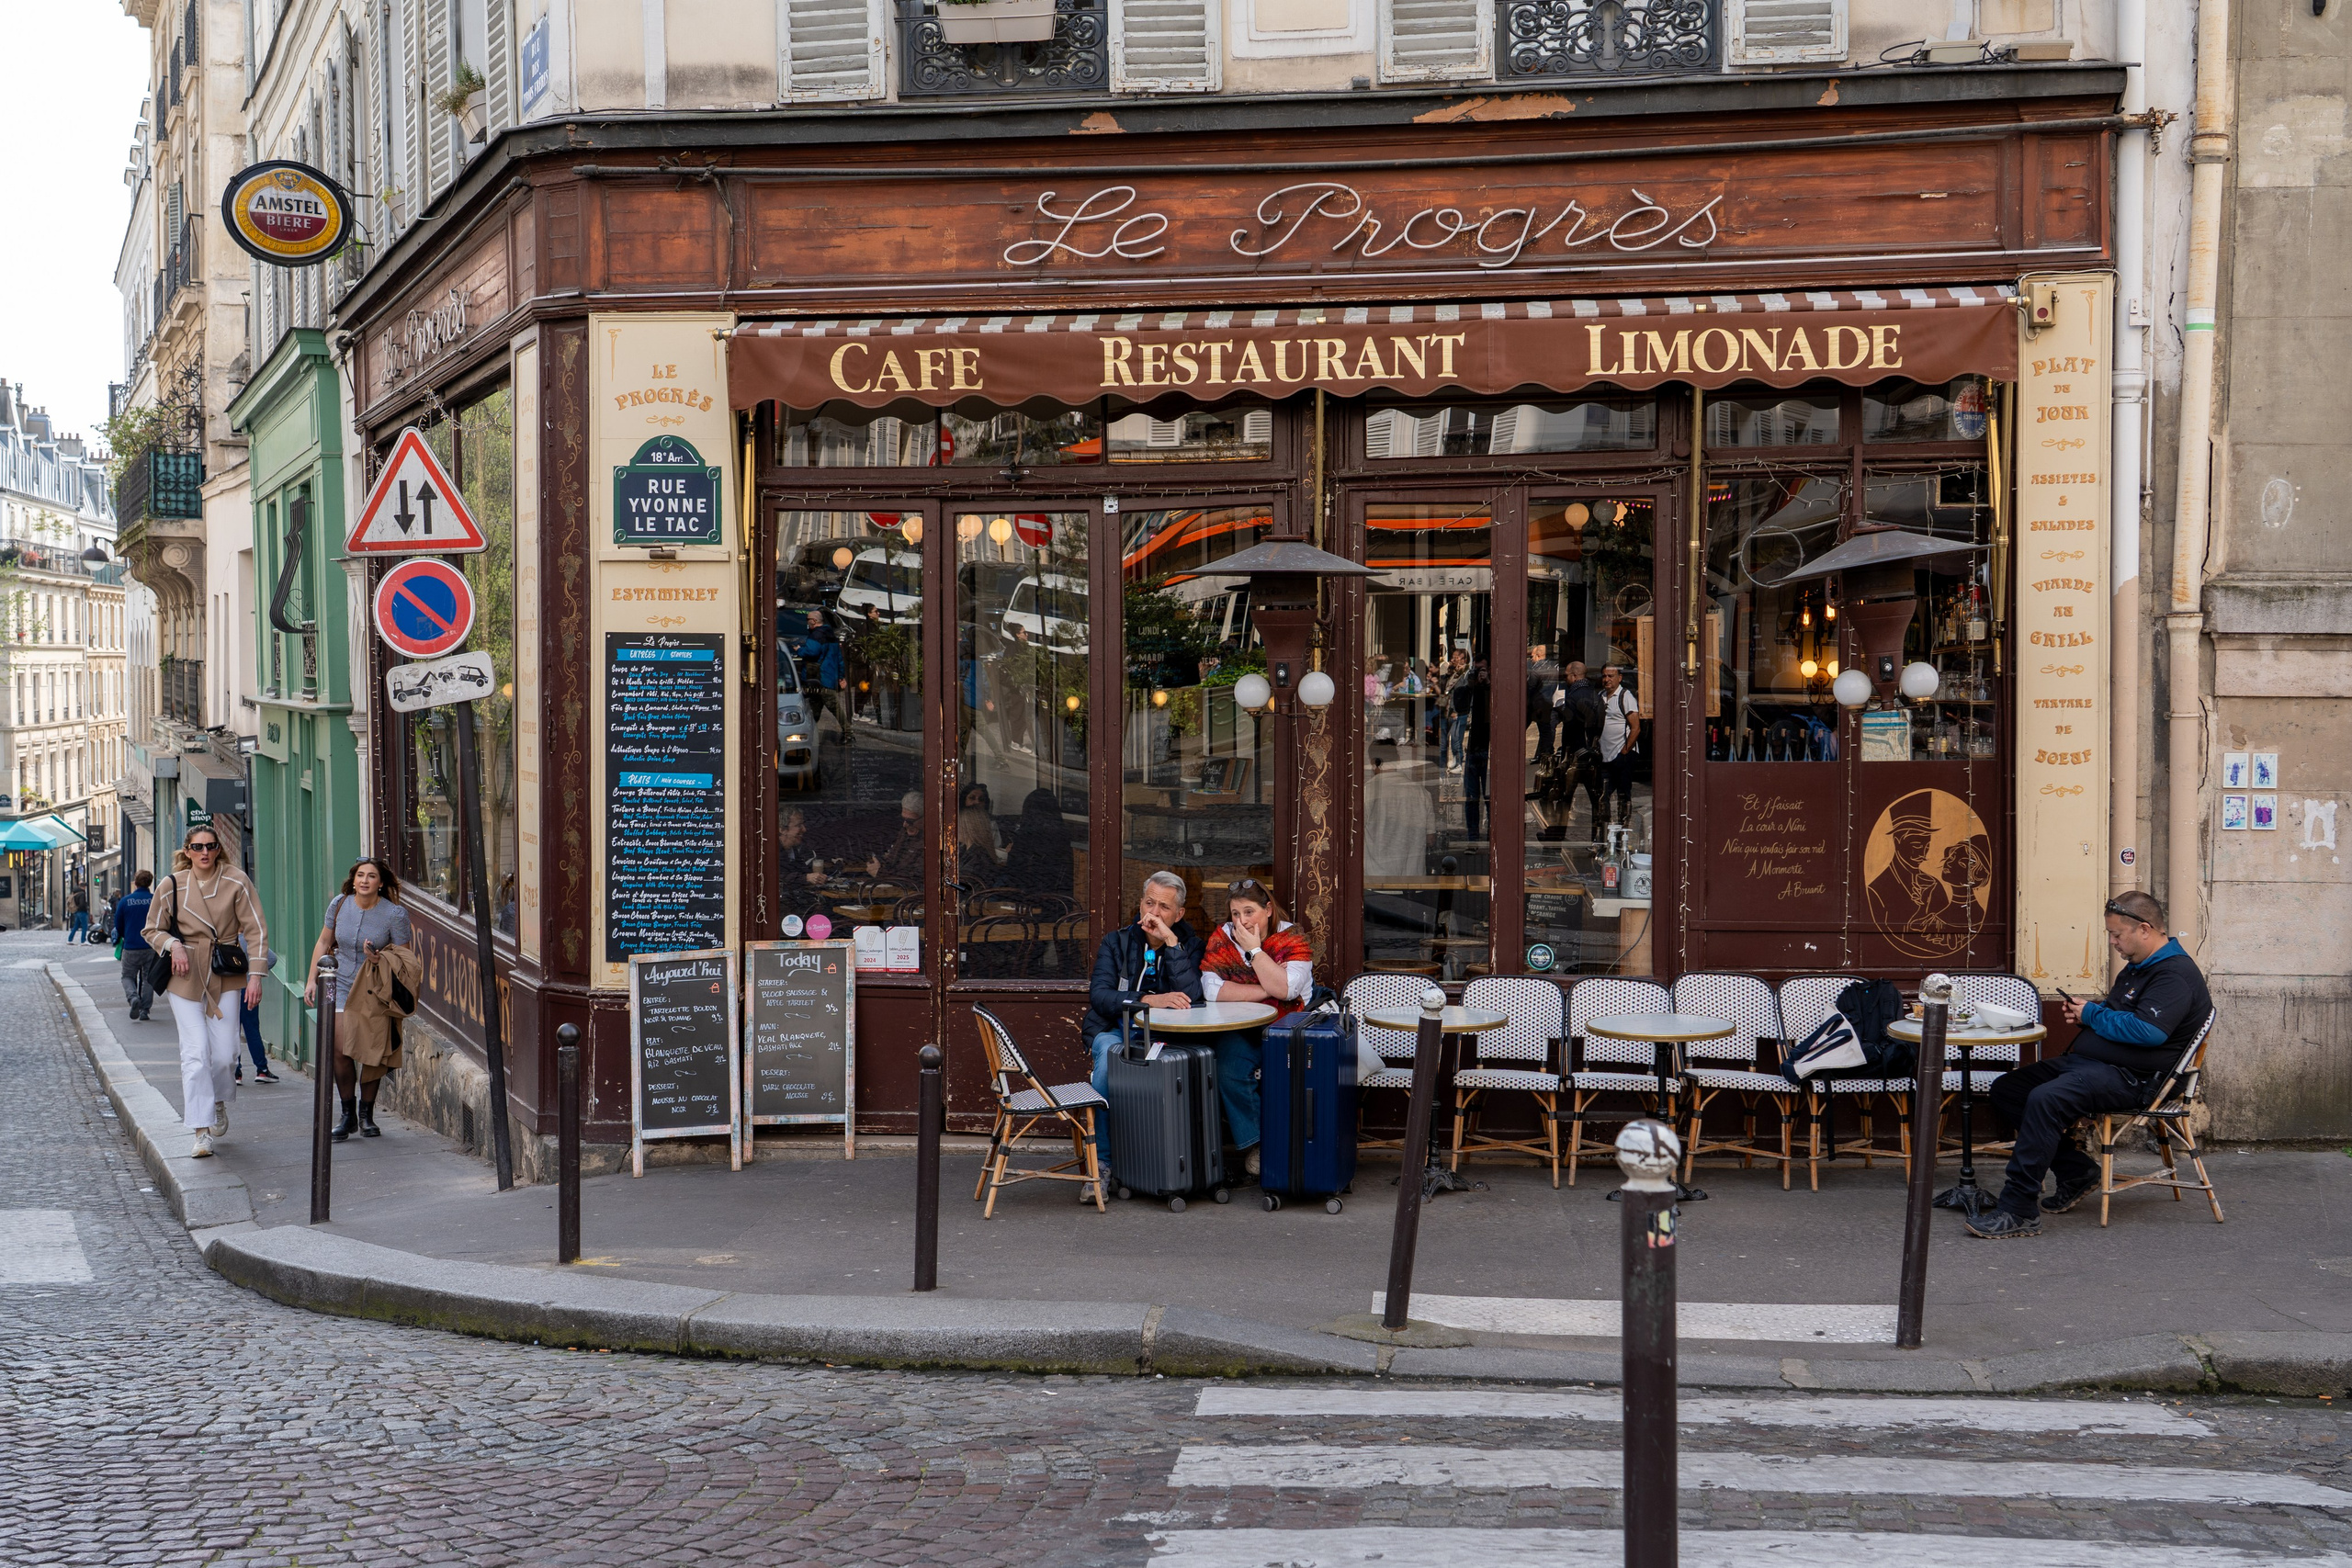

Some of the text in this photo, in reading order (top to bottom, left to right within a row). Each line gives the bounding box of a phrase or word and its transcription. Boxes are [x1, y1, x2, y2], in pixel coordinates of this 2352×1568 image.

[255, 195, 322, 215] AMSTEL
[266, 215, 311, 229] BIERE
[1003, 182, 1724, 269] Le Progrès
[380, 289, 470, 386] Le Progrès
[829, 322, 1904, 394] CAFE RESTAURANT LIMONADE
[652, 364, 678, 379] LE
[2031, 356, 2096, 377] PLAT
[2053, 384, 2071, 394] DU
[2036, 405, 2089, 423] JOUR
[648, 479, 686, 494] RUE
[628, 498, 707, 513] YVONNE
[635, 517, 700, 532] LE TAC
[2030, 520, 2095, 532] SALADES
[2031, 578, 2095, 593] VIANDE
[611, 587, 719, 602] ESTAMINET
[2053, 605, 2074, 617] AU
[643, 636, 655, 646] Le
[2030, 630, 2094, 648] GRILL
[630, 649, 656, 659] ENTRÉES
[2033, 698, 2093, 708] TARTARE
[2055, 726, 2073, 735] DE
[2034, 749, 2093, 765] BOEUF
[628, 773, 651, 785] PLATS
[1739, 817, 1754, 833] La
[1756, 821, 1775, 831] cour
[1781, 818, 1807, 834] Nini
[1719, 839, 1743, 854] Nini
[1744, 843, 1759, 860] qui
[1812, 840, 1826, 853] nid
[1745, 860, 1757, 878] A
[1793, 881, 1826, 897] Bruant
[429, 935, 437, 992] &
[775, 952, 820, 974] Today
[645, 962, 723, 986] Aujourd'hui
[758, 1034, 776, 1043] VEAL
[645, 1047, 689, 1058] BLANQUETTE
[758, 1044, 787, 1053] BASMATI
[652, 1097, 675, 1105] MOUSSE
